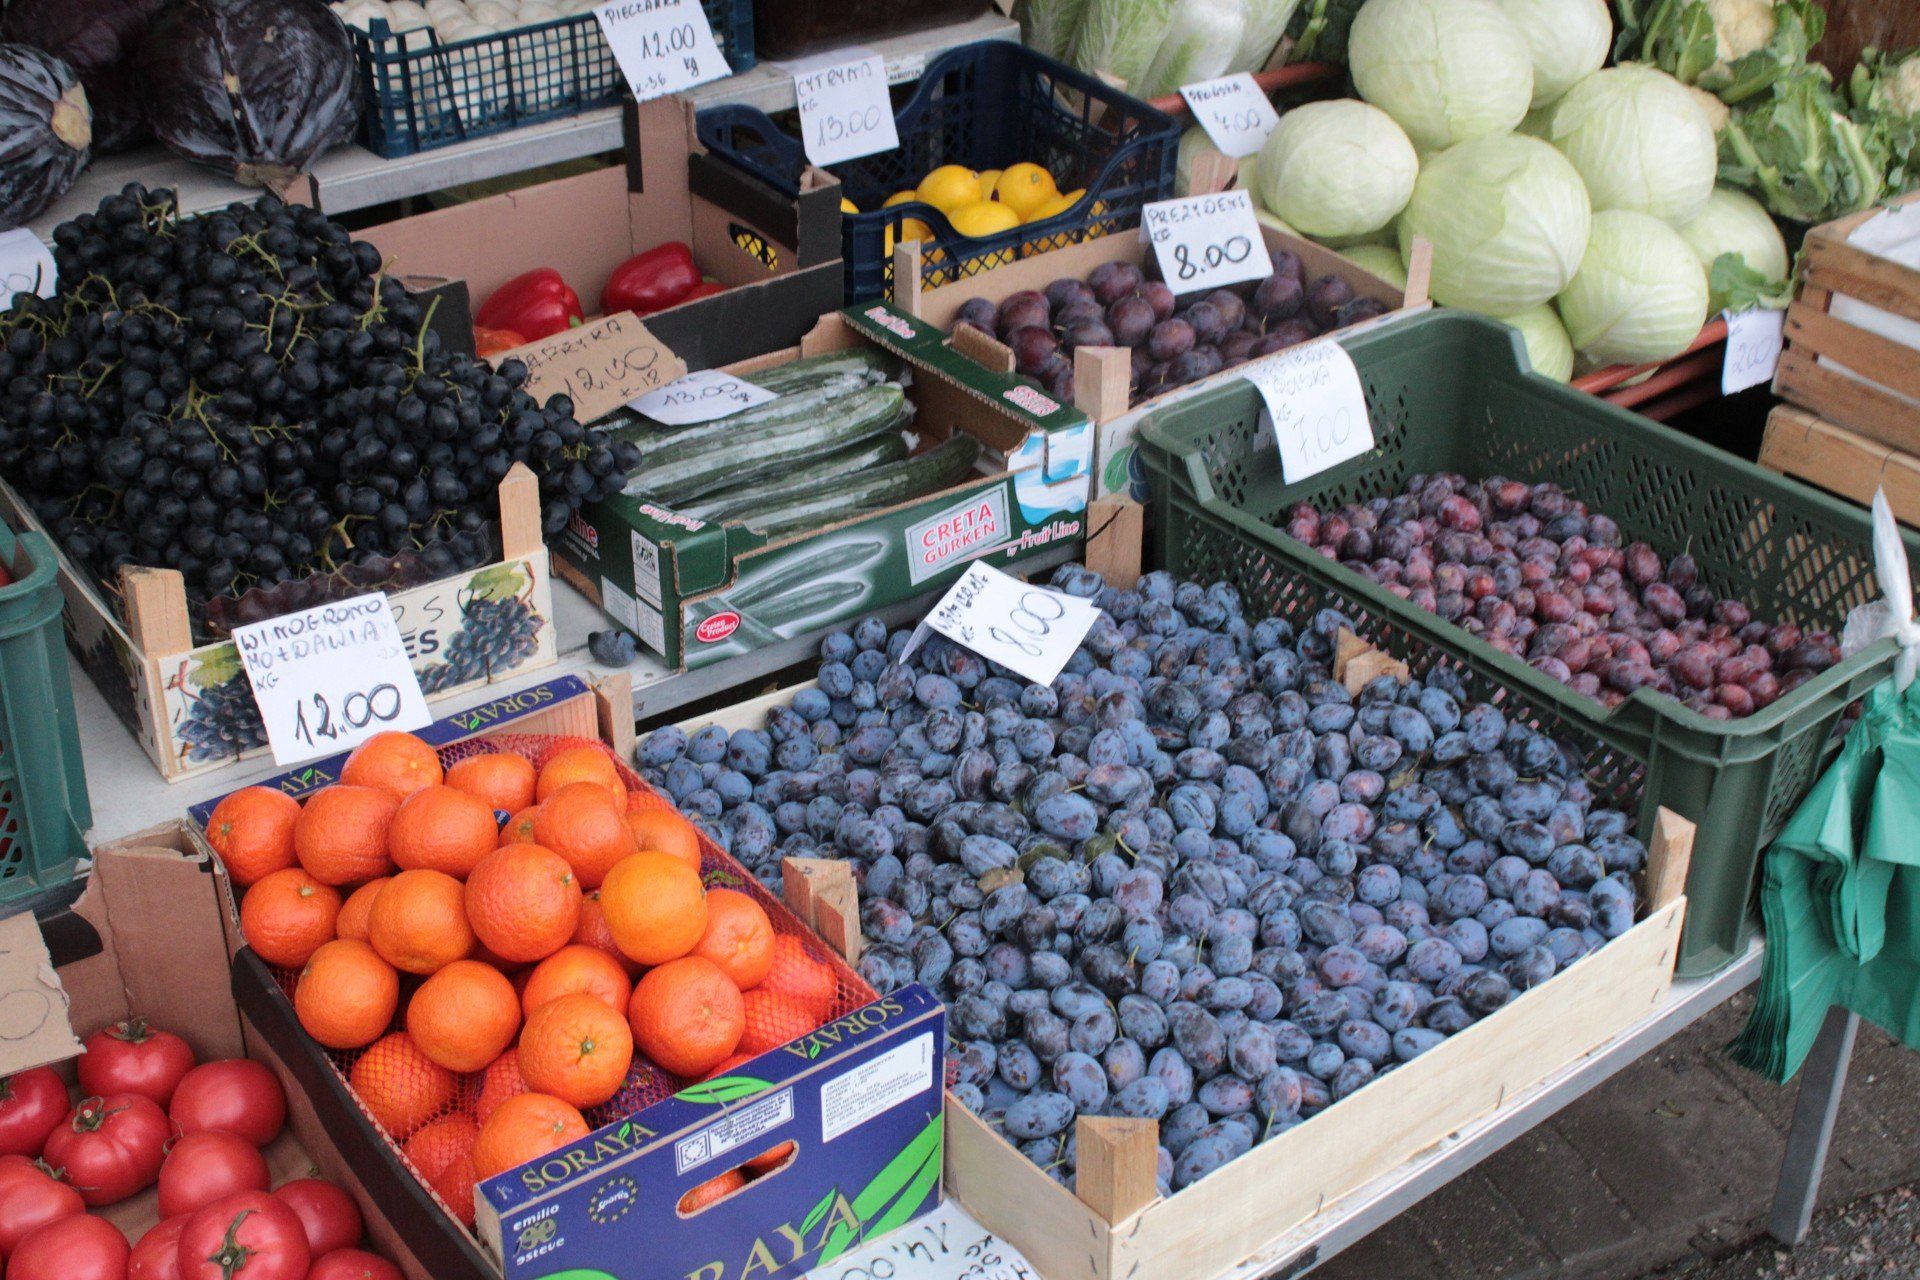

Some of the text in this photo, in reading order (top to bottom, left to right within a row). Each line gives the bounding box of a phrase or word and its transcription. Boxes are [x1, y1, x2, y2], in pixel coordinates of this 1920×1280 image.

[921, 501, 993, 549] CRETA
[924, 520, 997, 565] GURKEN
[1020, 526, 1052, 551] Fruit
[1052, 518, 1081, 542] Line
[450, 686, 554, 730] SORAYA
[783, 997, 904, 1060] SORAYA
[522, 1121, 659, 1193] SORAYA
[512, 1203, 560, 1232] emilio
